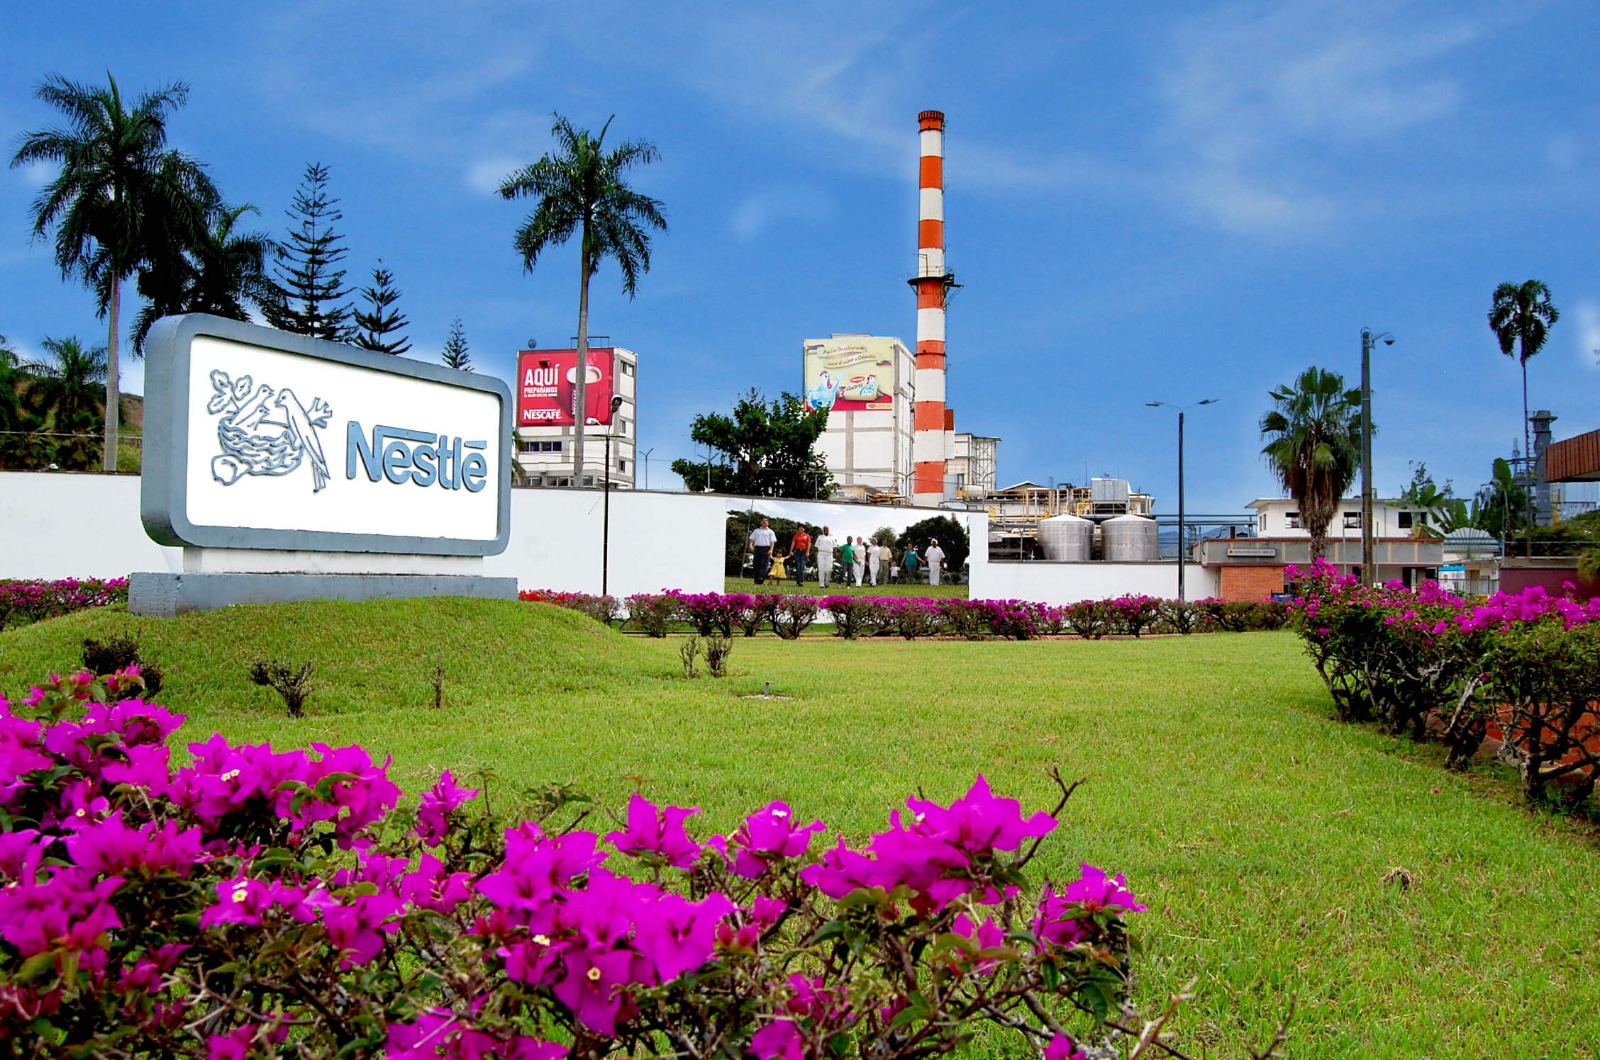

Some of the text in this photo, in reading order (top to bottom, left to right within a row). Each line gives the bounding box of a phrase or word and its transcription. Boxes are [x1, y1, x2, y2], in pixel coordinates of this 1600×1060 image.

[525, 364, 560, 387] AQUÍ
[523, 409, 562, 420] NESCAFÉ
[346, 420, 488, 493] Nestlé
